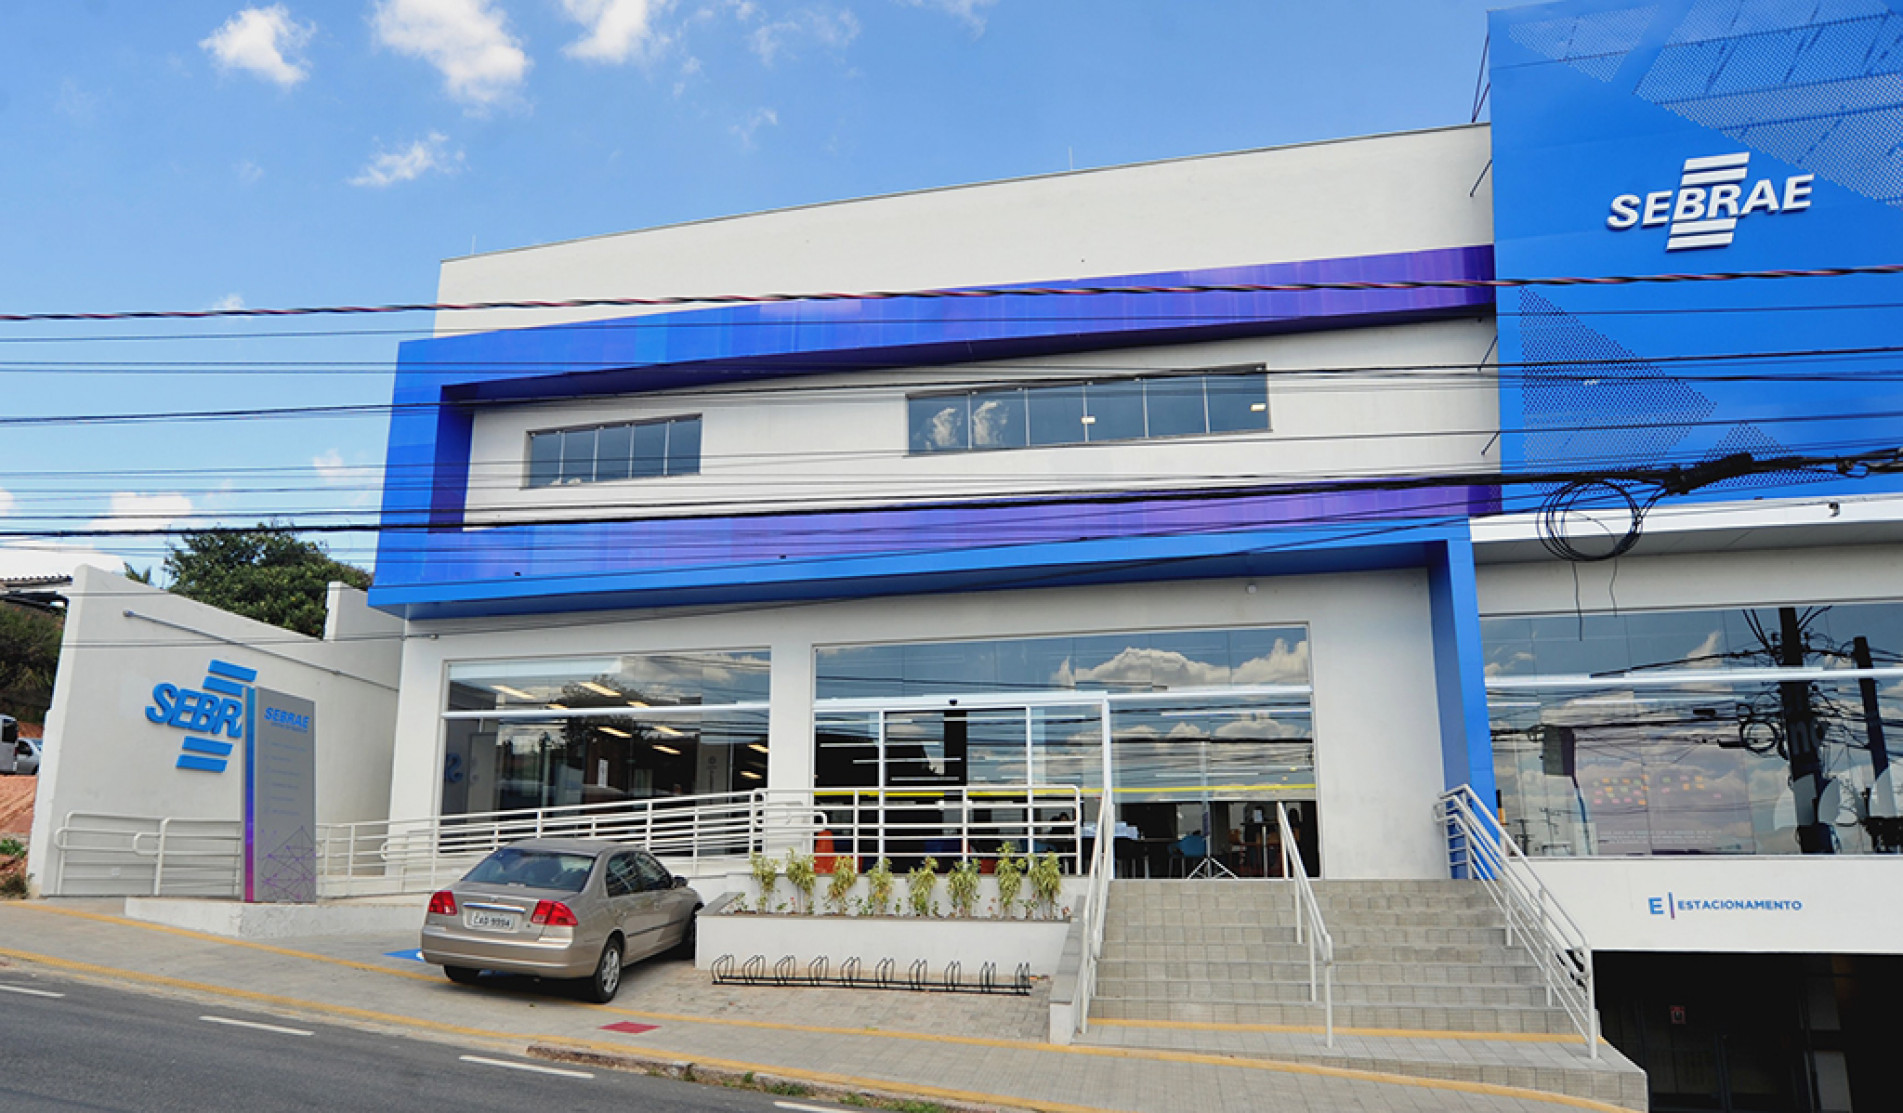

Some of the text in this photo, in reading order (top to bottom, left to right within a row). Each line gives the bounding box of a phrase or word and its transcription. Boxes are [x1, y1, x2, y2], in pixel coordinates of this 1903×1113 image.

[1606, 173, 1815, 229] SEBRAE
[145, 682, 243, 738] SEBR
[264, 707, 310, 729] SEBRAE
[1648, 897, 1803, 915] E ESTACIONAMENTO
